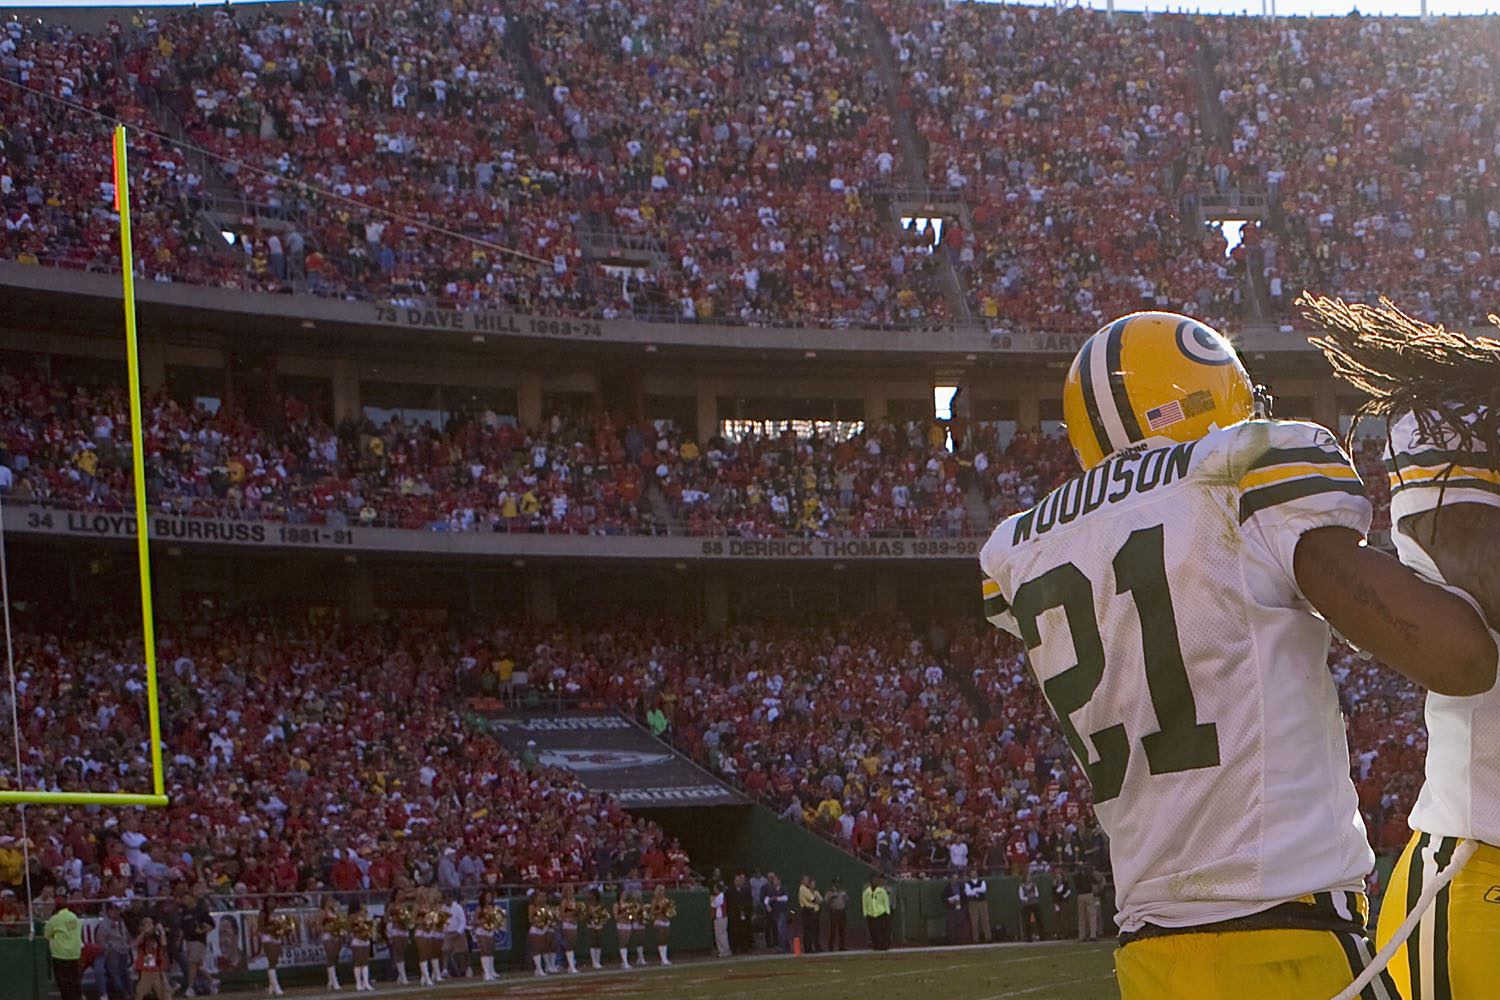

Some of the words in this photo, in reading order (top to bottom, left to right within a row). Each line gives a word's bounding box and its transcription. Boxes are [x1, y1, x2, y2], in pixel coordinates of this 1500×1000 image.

[375, 307, 397, 323] 73
[407, 309, 464, 329] DAVE
[474, 313, 521, 333] HILL
[1012, 440, 1199, 547] WOODSON
[27, 512, 54, 530] 34
[67, 513, 138, 537] LLOYD
[155, 518, 266, 543] BURRUSS
[279, 528, 354, 546] 1981-91
[729, 540, 816, 556] DERRICK
[821, 540, 905, 556] THOMAS
[1011, 523, 1221, 805] 21
